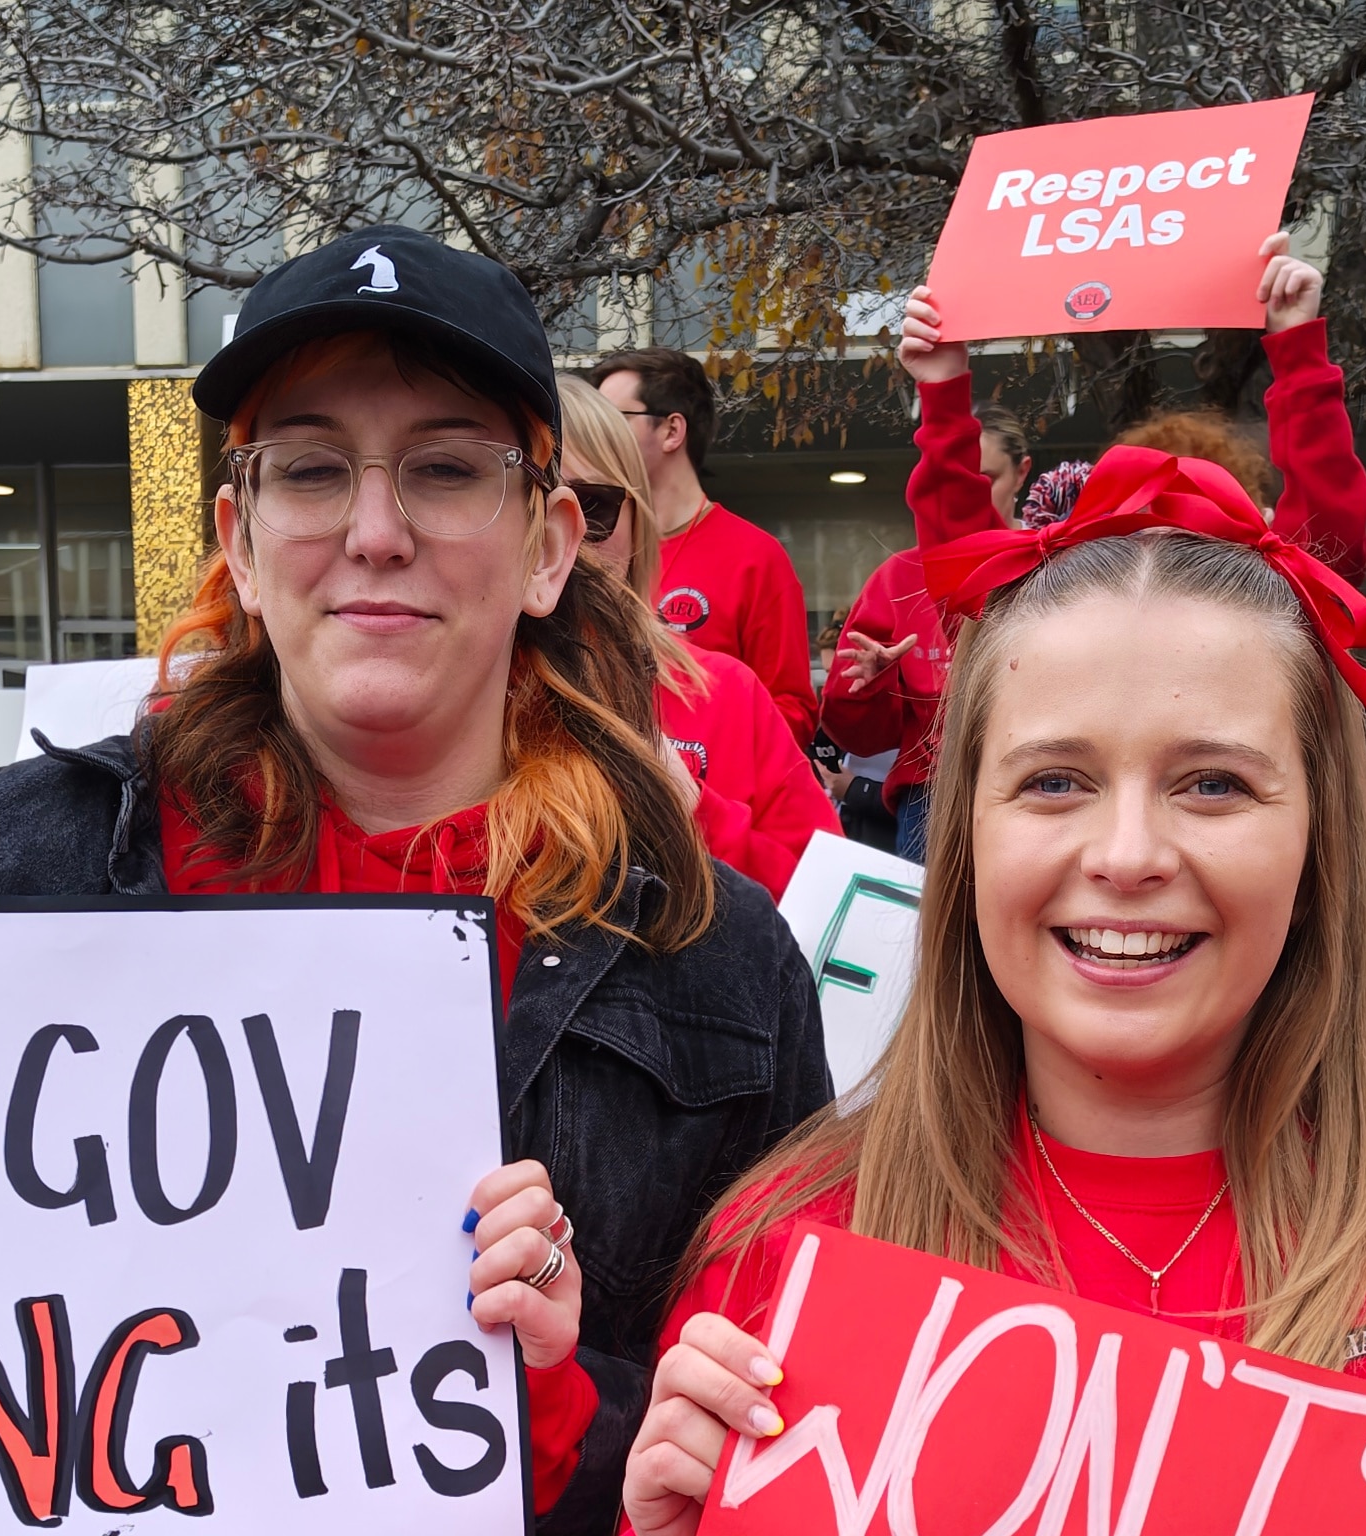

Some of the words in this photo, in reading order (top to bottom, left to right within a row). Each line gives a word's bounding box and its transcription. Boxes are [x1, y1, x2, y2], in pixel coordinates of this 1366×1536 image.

[987, 147, 1256, 211] Respect
[1021, 204, 1186, 257] LSAs
[4, 1009, 363, 1230] GOV
[283, 1267, 508, 1498] its
